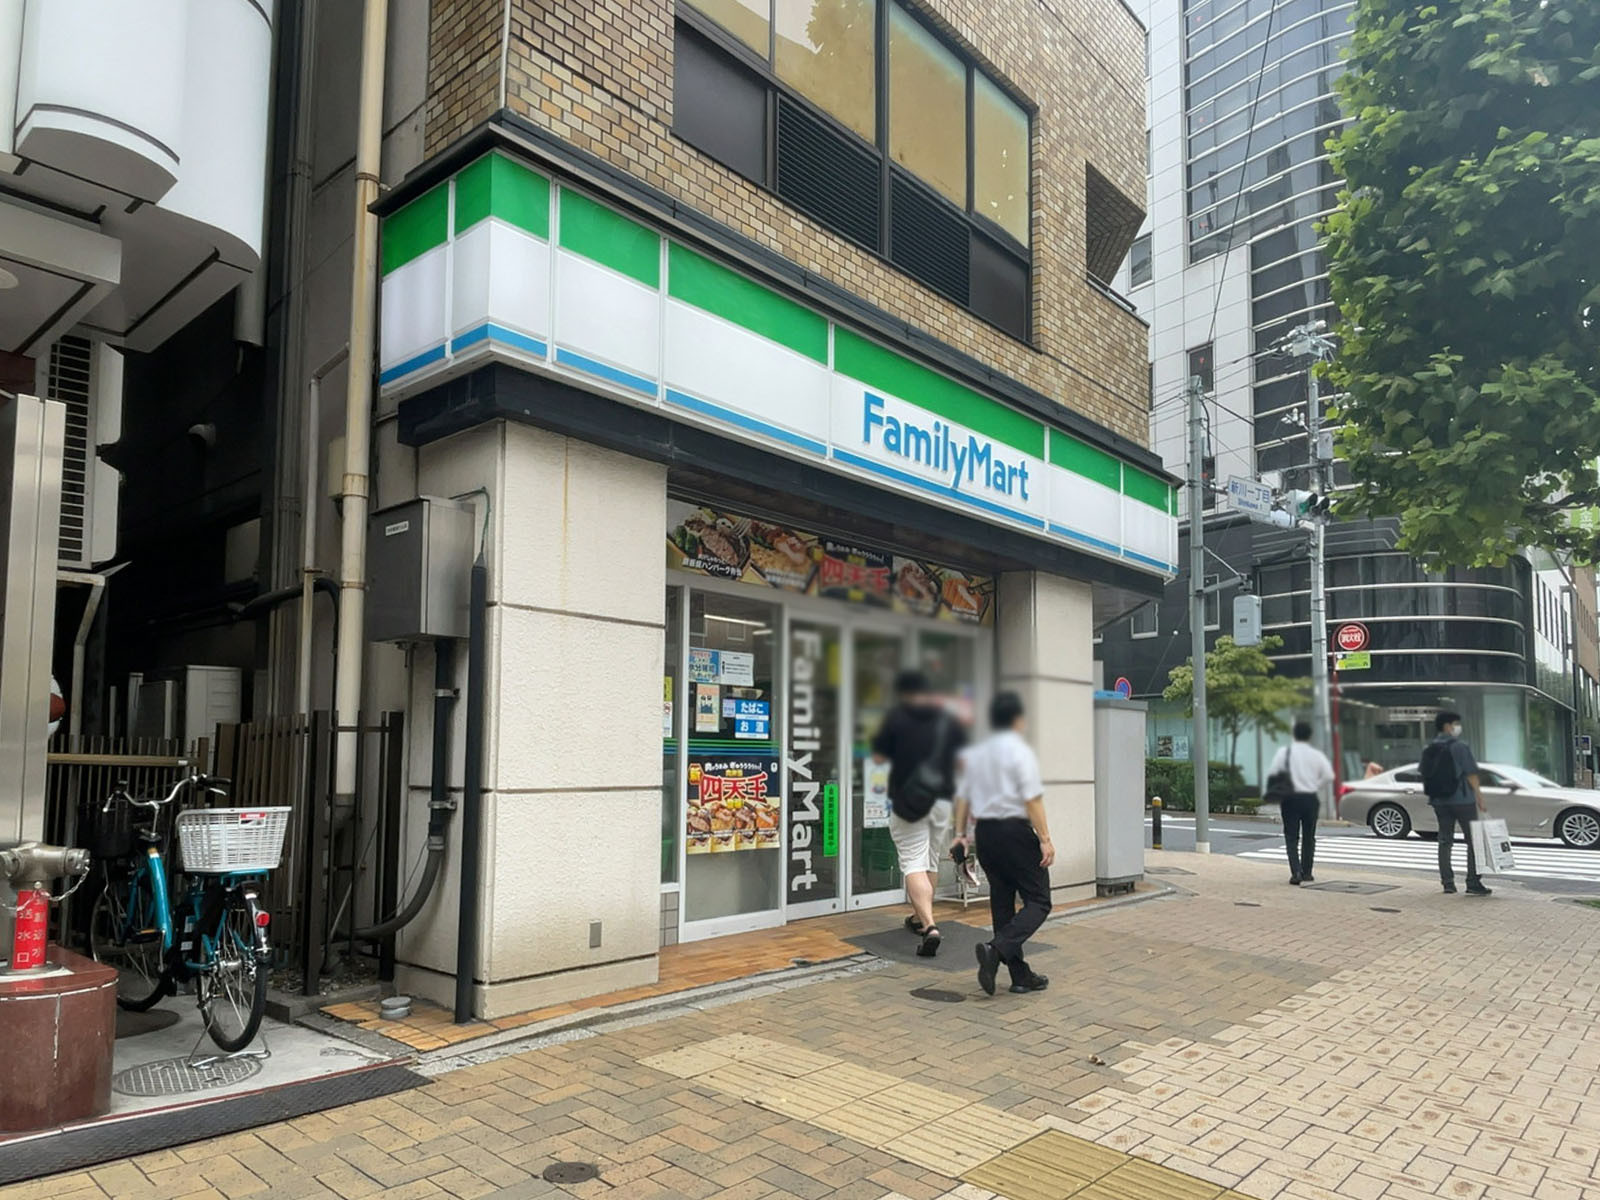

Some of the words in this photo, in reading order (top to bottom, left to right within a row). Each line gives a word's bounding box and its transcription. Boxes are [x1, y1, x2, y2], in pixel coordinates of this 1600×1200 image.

[864, 391, 1028, 501] FamilyMart
[741, 702, 764, 714] たばこ
[700, 772, 768, 806] 四天王
[786, 630, 821, 891] FamilyMart
